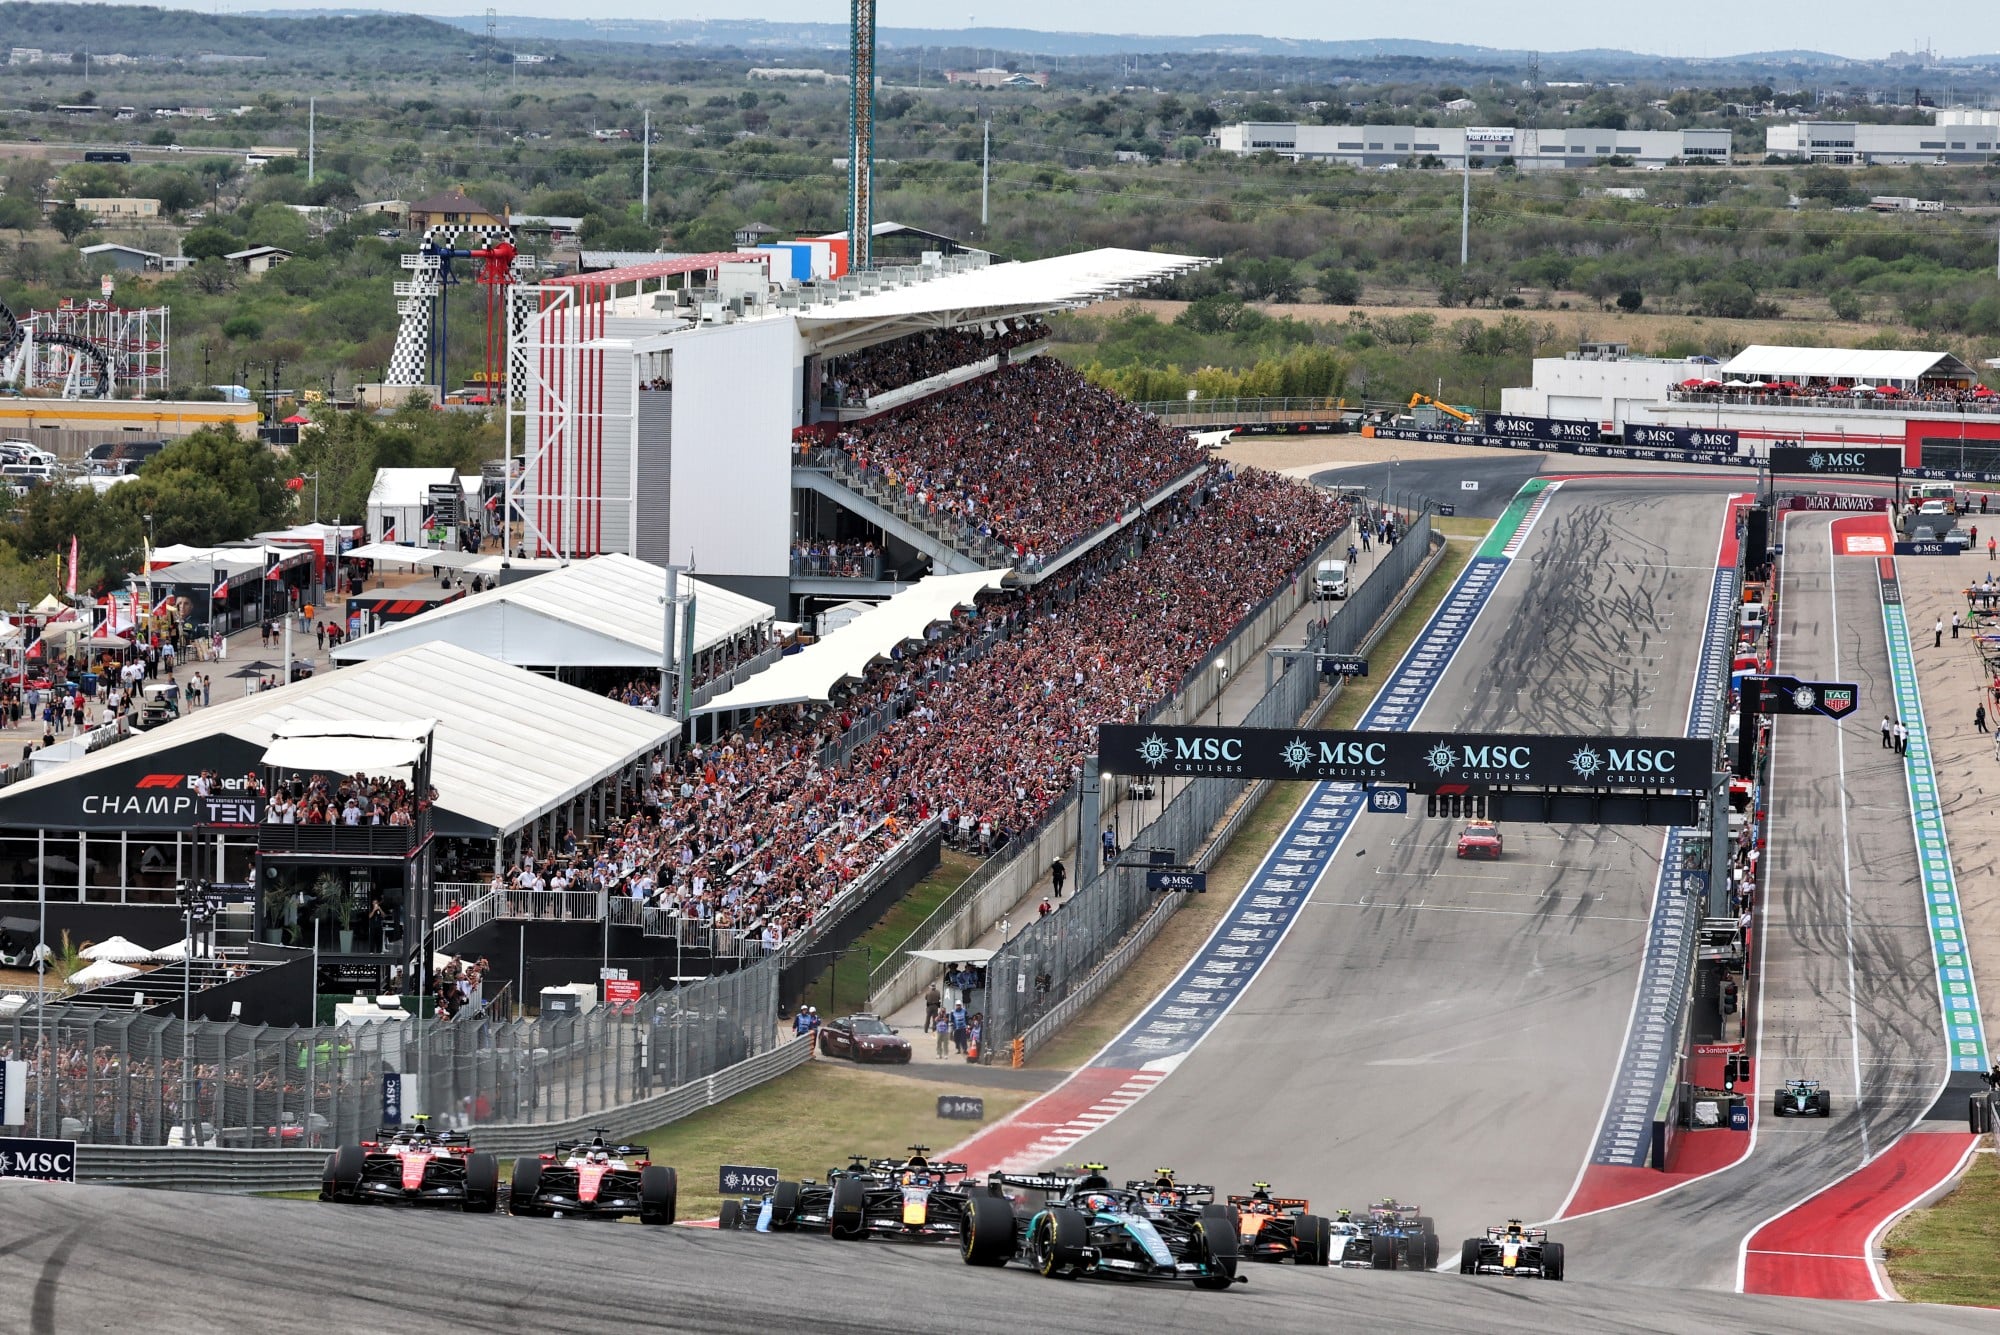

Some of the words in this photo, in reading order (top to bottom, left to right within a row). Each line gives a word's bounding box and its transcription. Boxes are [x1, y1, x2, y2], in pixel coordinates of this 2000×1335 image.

[1508, 420, 1535, 432] MSC
[1564, 425, 1591, 436] MSC
[1648, 430, 1675, 442] MSC
[1704, 434, 1731, 446] MSC
[1828, 453, 1865, 466] MSC
[1805, 496, 1830, 510] QATAR
[1832, 496, 1874, 510] AIRWAYS
[1826, 699, 1849, 710] HEUER
[1175, 737, 1242, 762] MSC
[1318, 741, 1386, 765] MSC
[1462, 745, 1531, 769] MSC
[1607, 748, 1676, 772] MSC
[1175, 764, 1242, 773] CRUISES
[1318, 767, 1386, 777] CRUISES
[1462, 772, 1530, 781] CRUISES
[1607, 775, 1676, 784] CRUISES
[1375, 794, 1399, 807] FIA
[206, 804, 255, 822] TEN
[1171, 876, 1193, 885] MSC
[386, 1080, 396, 1104] MSC
[954, 1102, 982, 1112] MSC
[1732, 1114, 1746, 1123] FIA
[15, 1152, 71, 1173] MSC
[741, 1174, 776, 1187] MSC
